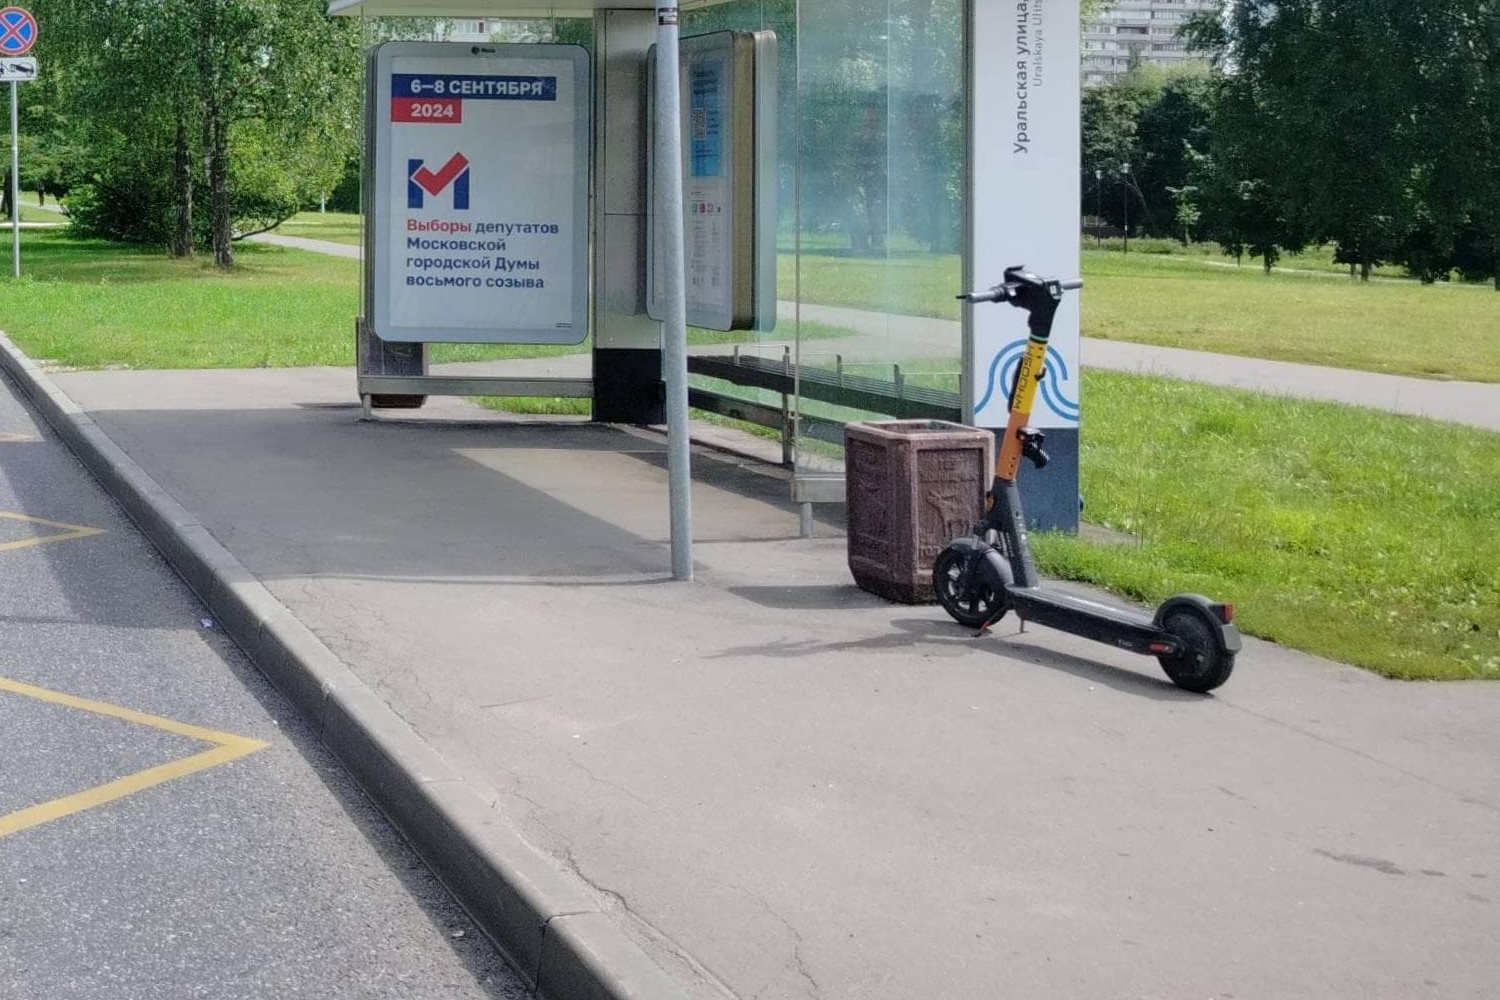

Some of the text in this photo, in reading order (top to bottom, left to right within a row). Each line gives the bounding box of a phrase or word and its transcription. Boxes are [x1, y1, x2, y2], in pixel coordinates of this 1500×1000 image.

[1032, 29, 1045, 87] Uralskaya
[449, 80, 543, 96] СЕНТЯБРЯ
[411, 103, 454, 118] 2024
[1013, 60, 1031, 154] Уральская
[407, 218, 559, 237] Выборы депутатов
[407, 237, 506, 251] Московской
[406, 256, 540, 272] городской Думы
[406, 275, 544, 289] восьмого созыва
[1013, 345, 1033, 409] WHOOSH
